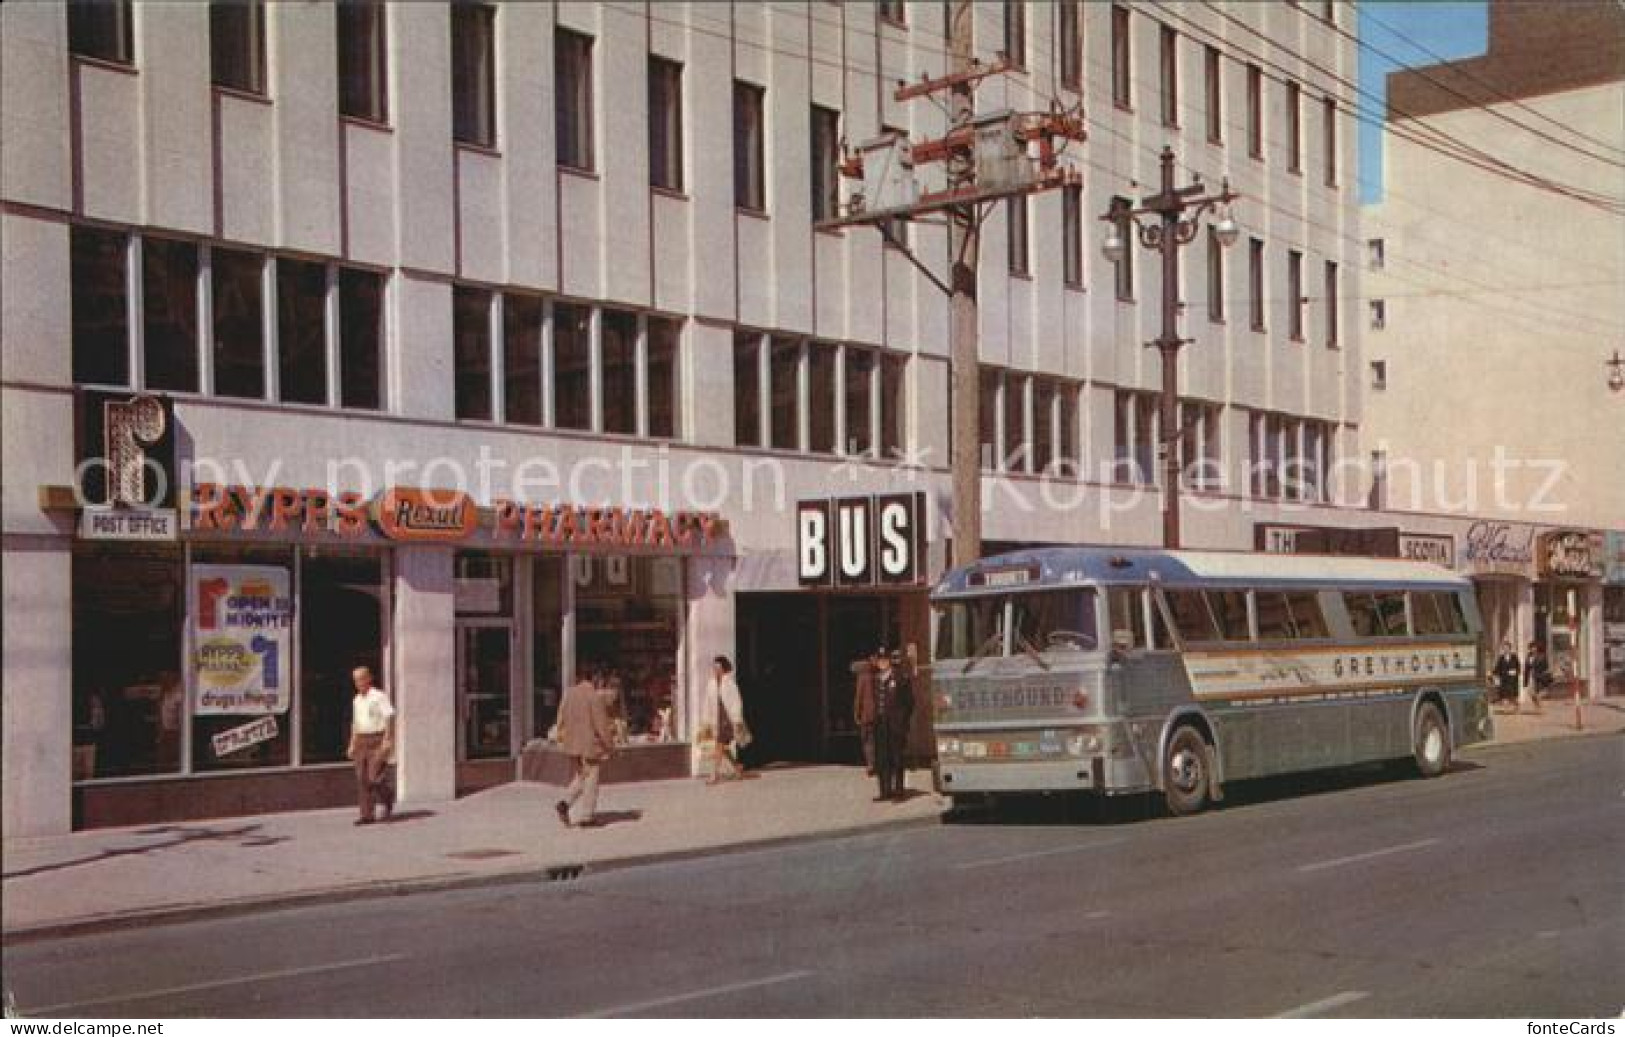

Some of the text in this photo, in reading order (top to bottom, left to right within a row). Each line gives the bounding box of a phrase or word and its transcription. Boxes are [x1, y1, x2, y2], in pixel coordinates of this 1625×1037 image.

[93, 515, 168, 534] POST OFFICE
[493, 500, 722, 548] PHARMACY
[800, 503, 909, 577] BUS
[1334, 651, 1463, 678] GREYHOUND
